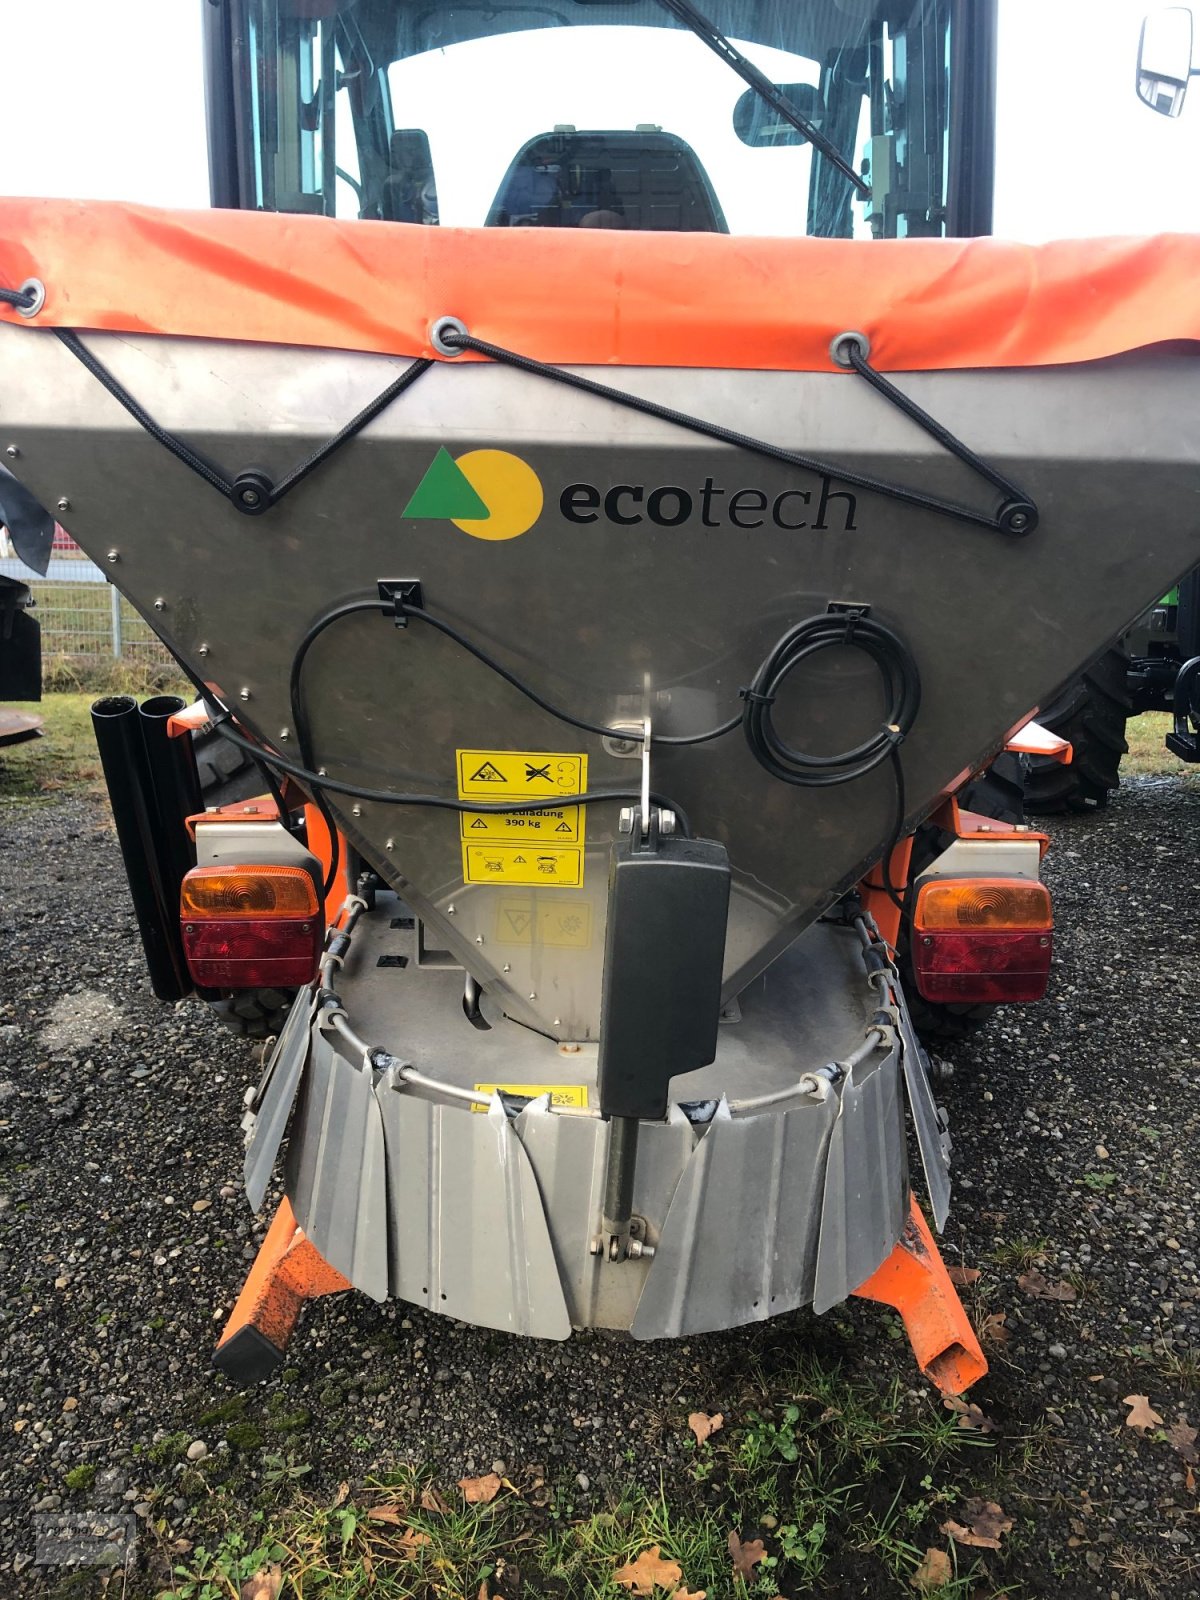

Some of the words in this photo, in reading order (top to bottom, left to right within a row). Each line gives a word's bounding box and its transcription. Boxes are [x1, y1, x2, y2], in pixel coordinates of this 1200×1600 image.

[559, 475, 857, 531] ecotech
[505, 819, 524, 827] 390
[528, 820, 540, 828] kg
